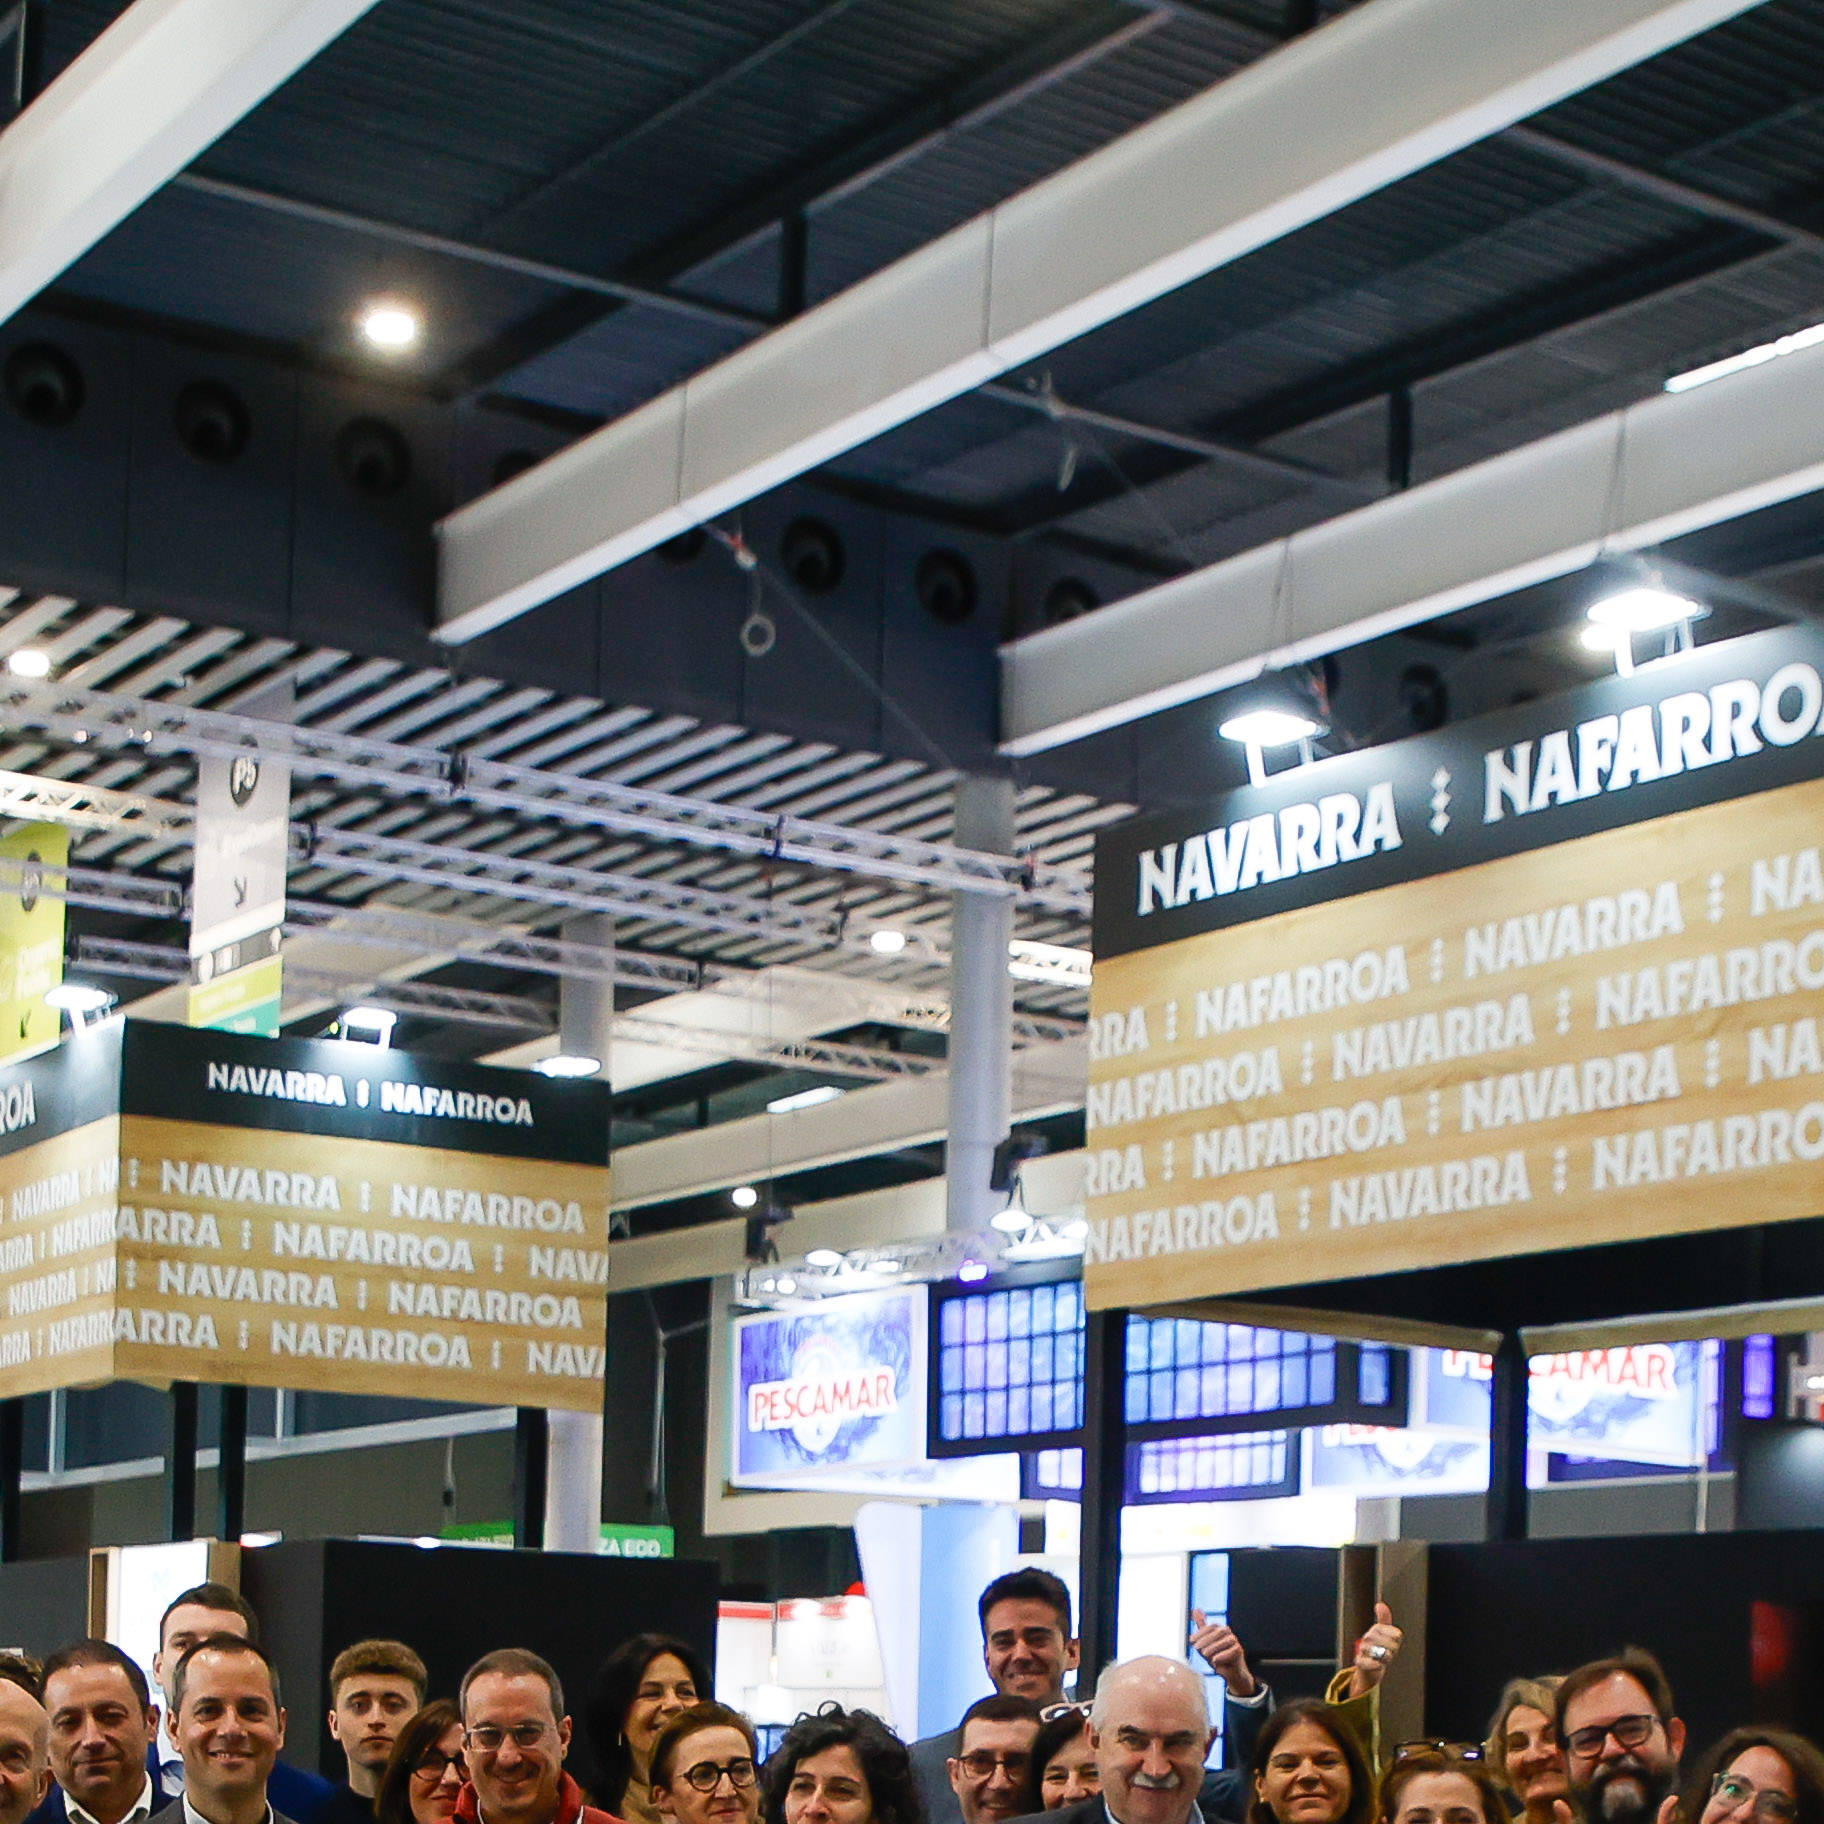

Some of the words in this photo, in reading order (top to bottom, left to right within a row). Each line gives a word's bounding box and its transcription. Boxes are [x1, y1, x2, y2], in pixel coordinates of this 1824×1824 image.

[1137, 781, 1403, 917] NAVARRA
[1195, 945, 1410, 1039] NAFARROA
[1463, 881, 1686, 979] NAVARRA
[208, 1062, 347, 1107] NAVARRA
[381, 1081, 535, 1128] NAFARROA
[1086, 1045, 1283, 1131] NAFARROA
[1332, 992, 1535, 1083] NAVARRA
[1192, 1095, 1407, 1180] NAFARROA
[1460, 1043, 1682, 1134] NAVARRA
[162, 1158, 341, 1211] NAVARRA
[390, 1183, 585, 1235] NAFARROA
[1084, 1190, 1280, 1267] NAFARROA
[1329, 1149, 1532, 1230] NAVARRA
[116, 1207, 222, 1249] ARRA
[274, 1221, 474, 1273] NAFARROA
[9, 1267, 76, 1315] NAVARRA
[158, 1260, 339, 1311] NAVARRA
[388, 1282, 583, 1330] NAFARROA
[114, 1308, 219, 1350] ARRA
[271, 1320, 472, 1370] NAFARROA
[754, 1373, 890, 1423] PESCAMAR
